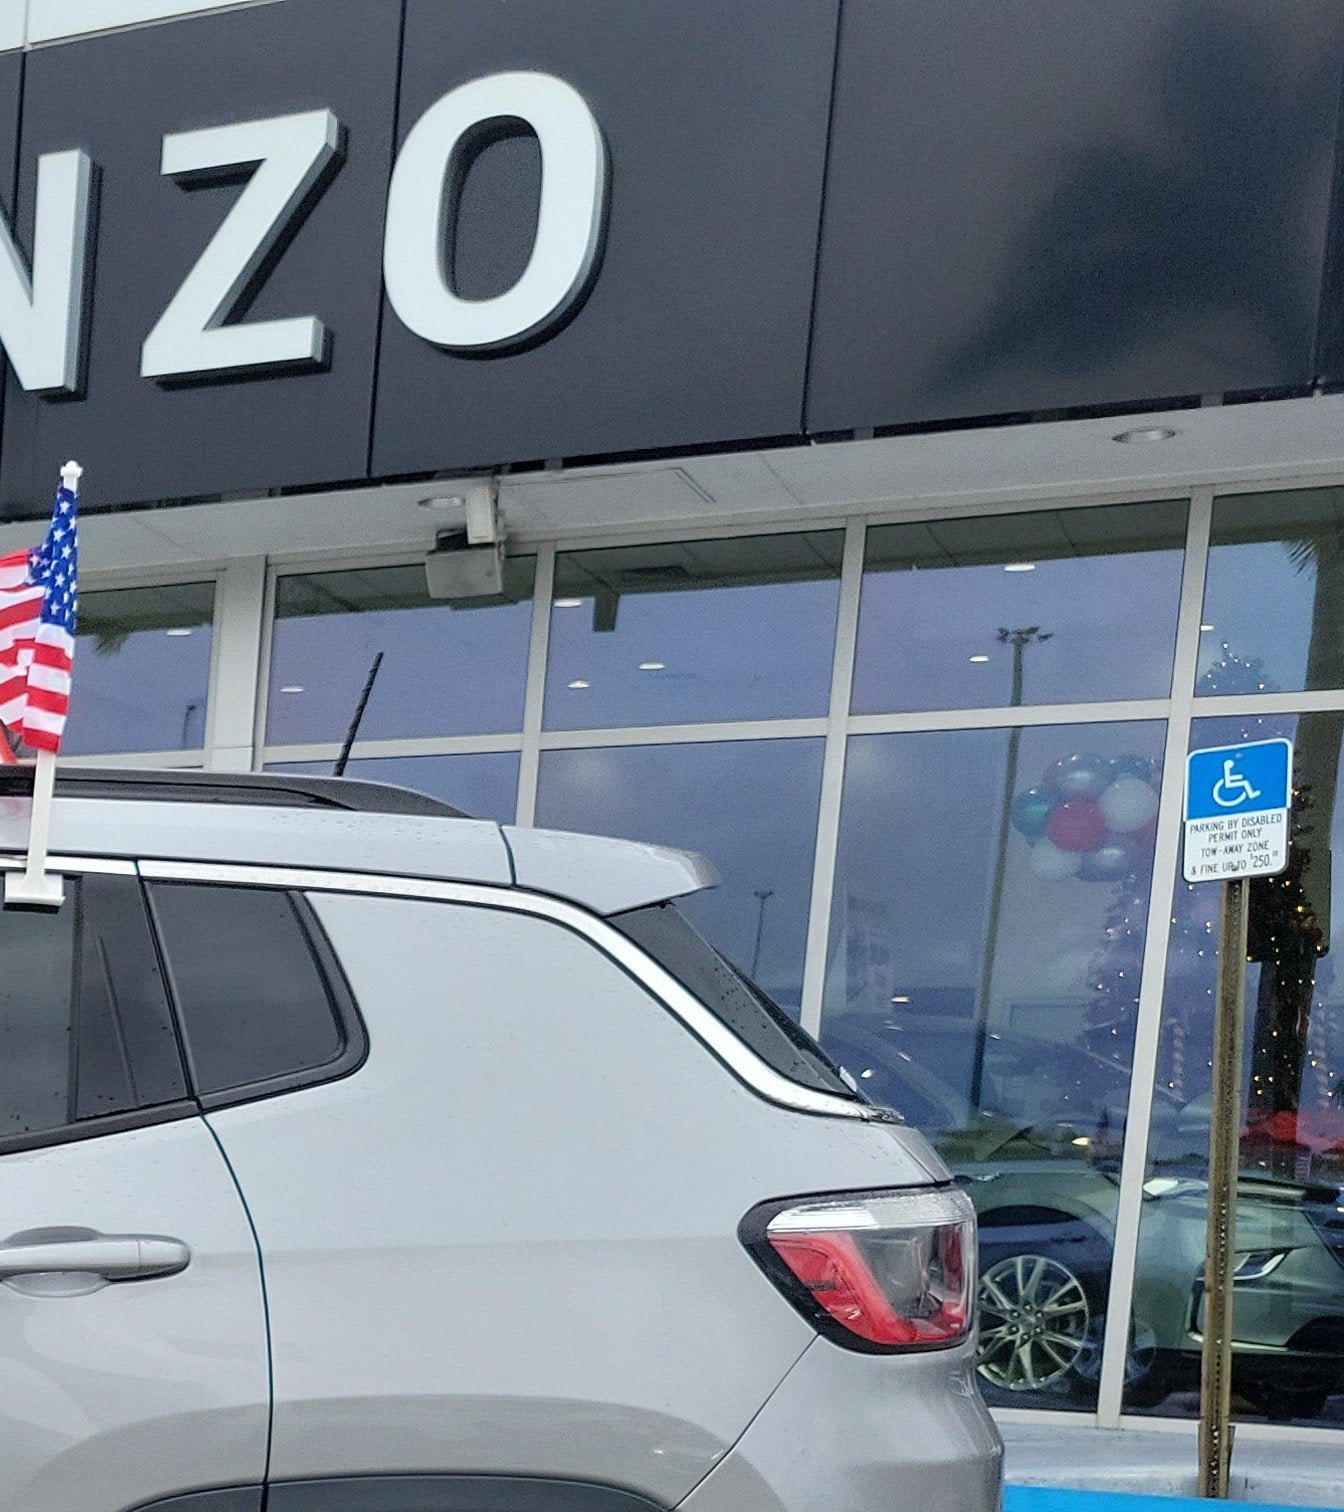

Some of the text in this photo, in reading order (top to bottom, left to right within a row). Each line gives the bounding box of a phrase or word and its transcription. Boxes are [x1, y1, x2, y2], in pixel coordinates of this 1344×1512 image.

[1190, 814, 1282, 833] PARKING BY DISABLED
[1208, 827, 1263, 843] PERMIT ONLY
[1247, 840, 1269, 852] ZONE
[1201, 864, 1218, 875] FINE
